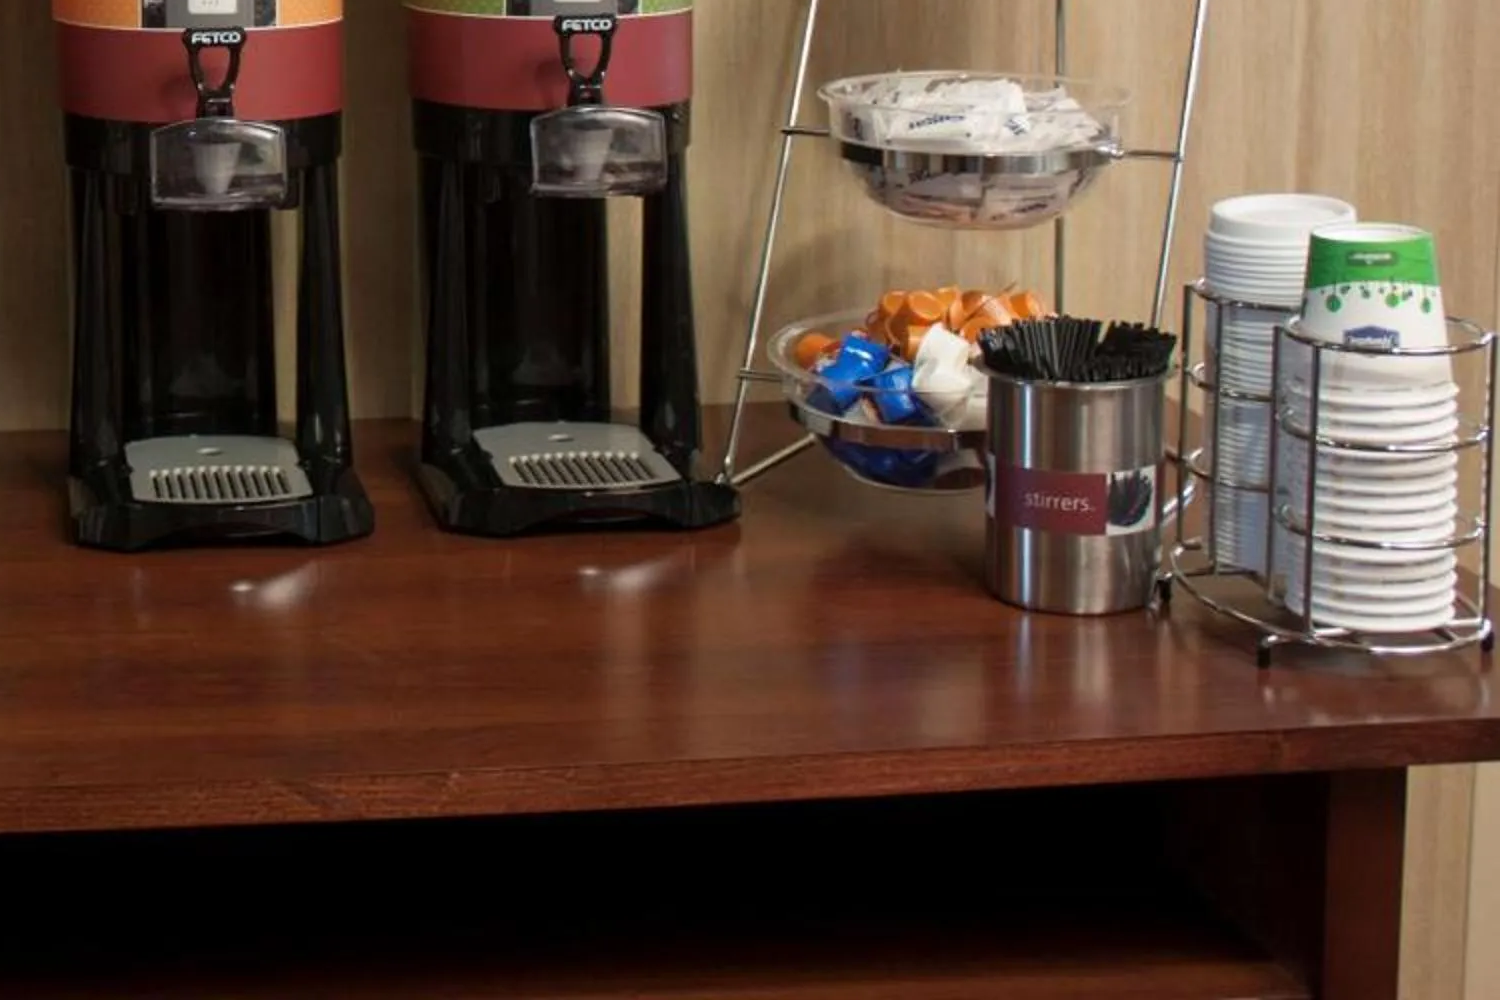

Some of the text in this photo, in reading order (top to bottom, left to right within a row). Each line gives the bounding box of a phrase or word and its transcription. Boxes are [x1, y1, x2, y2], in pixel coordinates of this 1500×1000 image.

[562, 19, 612, 31] FETCO
[192, 32, 241, 45] FETCO
[1024, 492, 1096, 512] stirrers.
